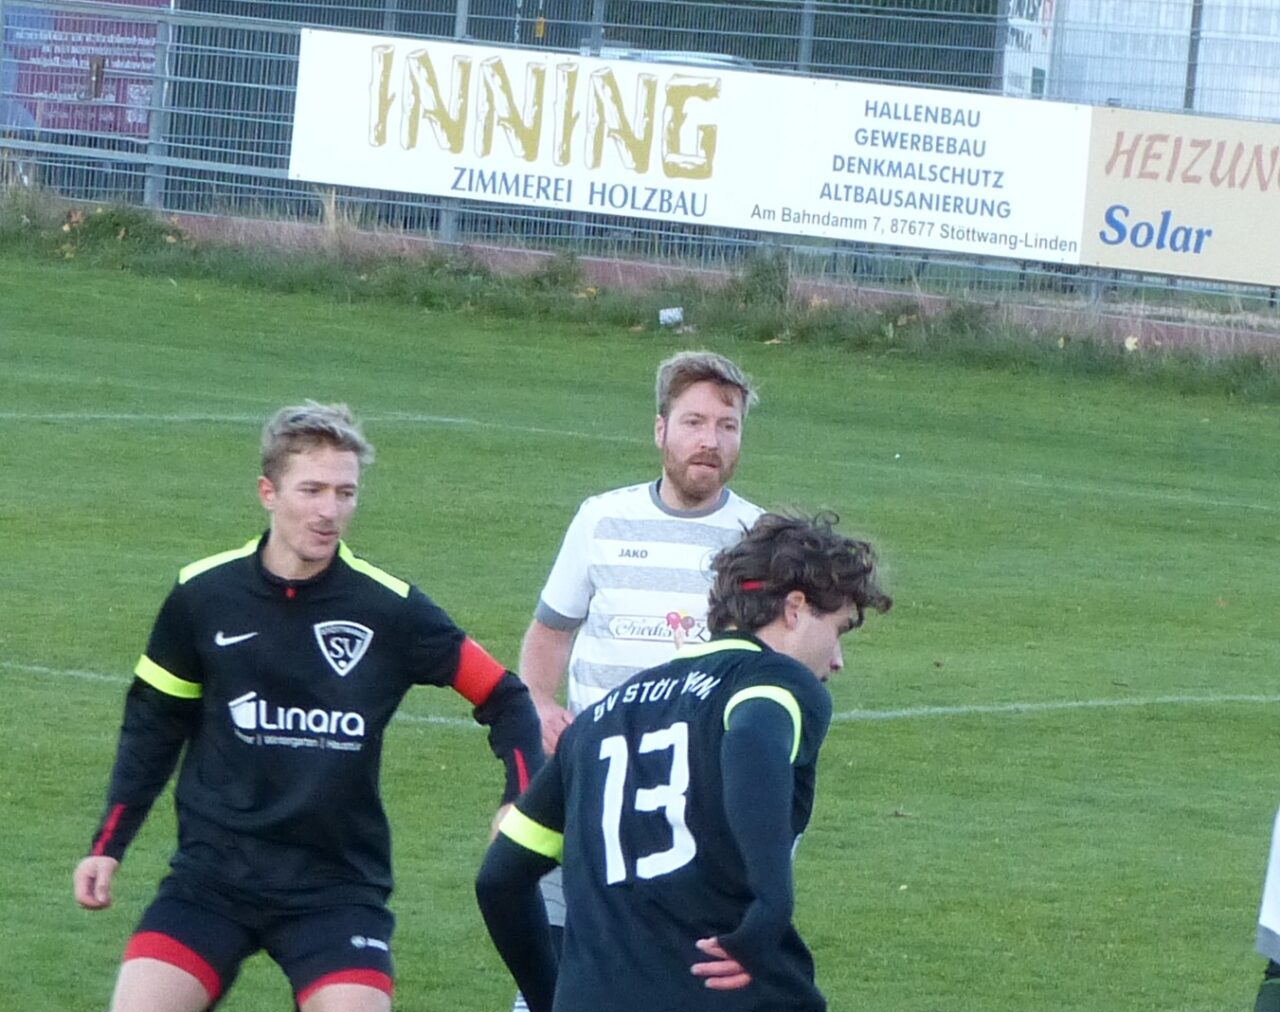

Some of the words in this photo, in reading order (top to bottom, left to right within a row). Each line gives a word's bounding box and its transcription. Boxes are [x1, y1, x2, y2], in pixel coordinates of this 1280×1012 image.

[367, 43, 722, 180] INNING
[863, 99, 982, 128] HALLENBAU
[854, 128, 986, 158] GEWERBEBAU
[831, 154, 1005, 189] DENKMALSCHUTZ
[451, 166, 574, 203] ZIMMEREI
[588, 181, 709, 218] HOLZBAU
[819, 182, 1012, 219] ALTBAUSANIERUNG
[750, 203, 776, 221] Am
[781, 206, 868, 231] Bahndamm
[873, 216, 885, 235] 7,
[890, 218, 936, 238] 87677
[940, 222, 1078, 253] Stöttwang-Linden
[1099, 204, 1213, 255] Solar
[618, 547, 649, 559] JAKO
[258, 698, 366, 737] Linara
[598, 721, 698, 886] 13
